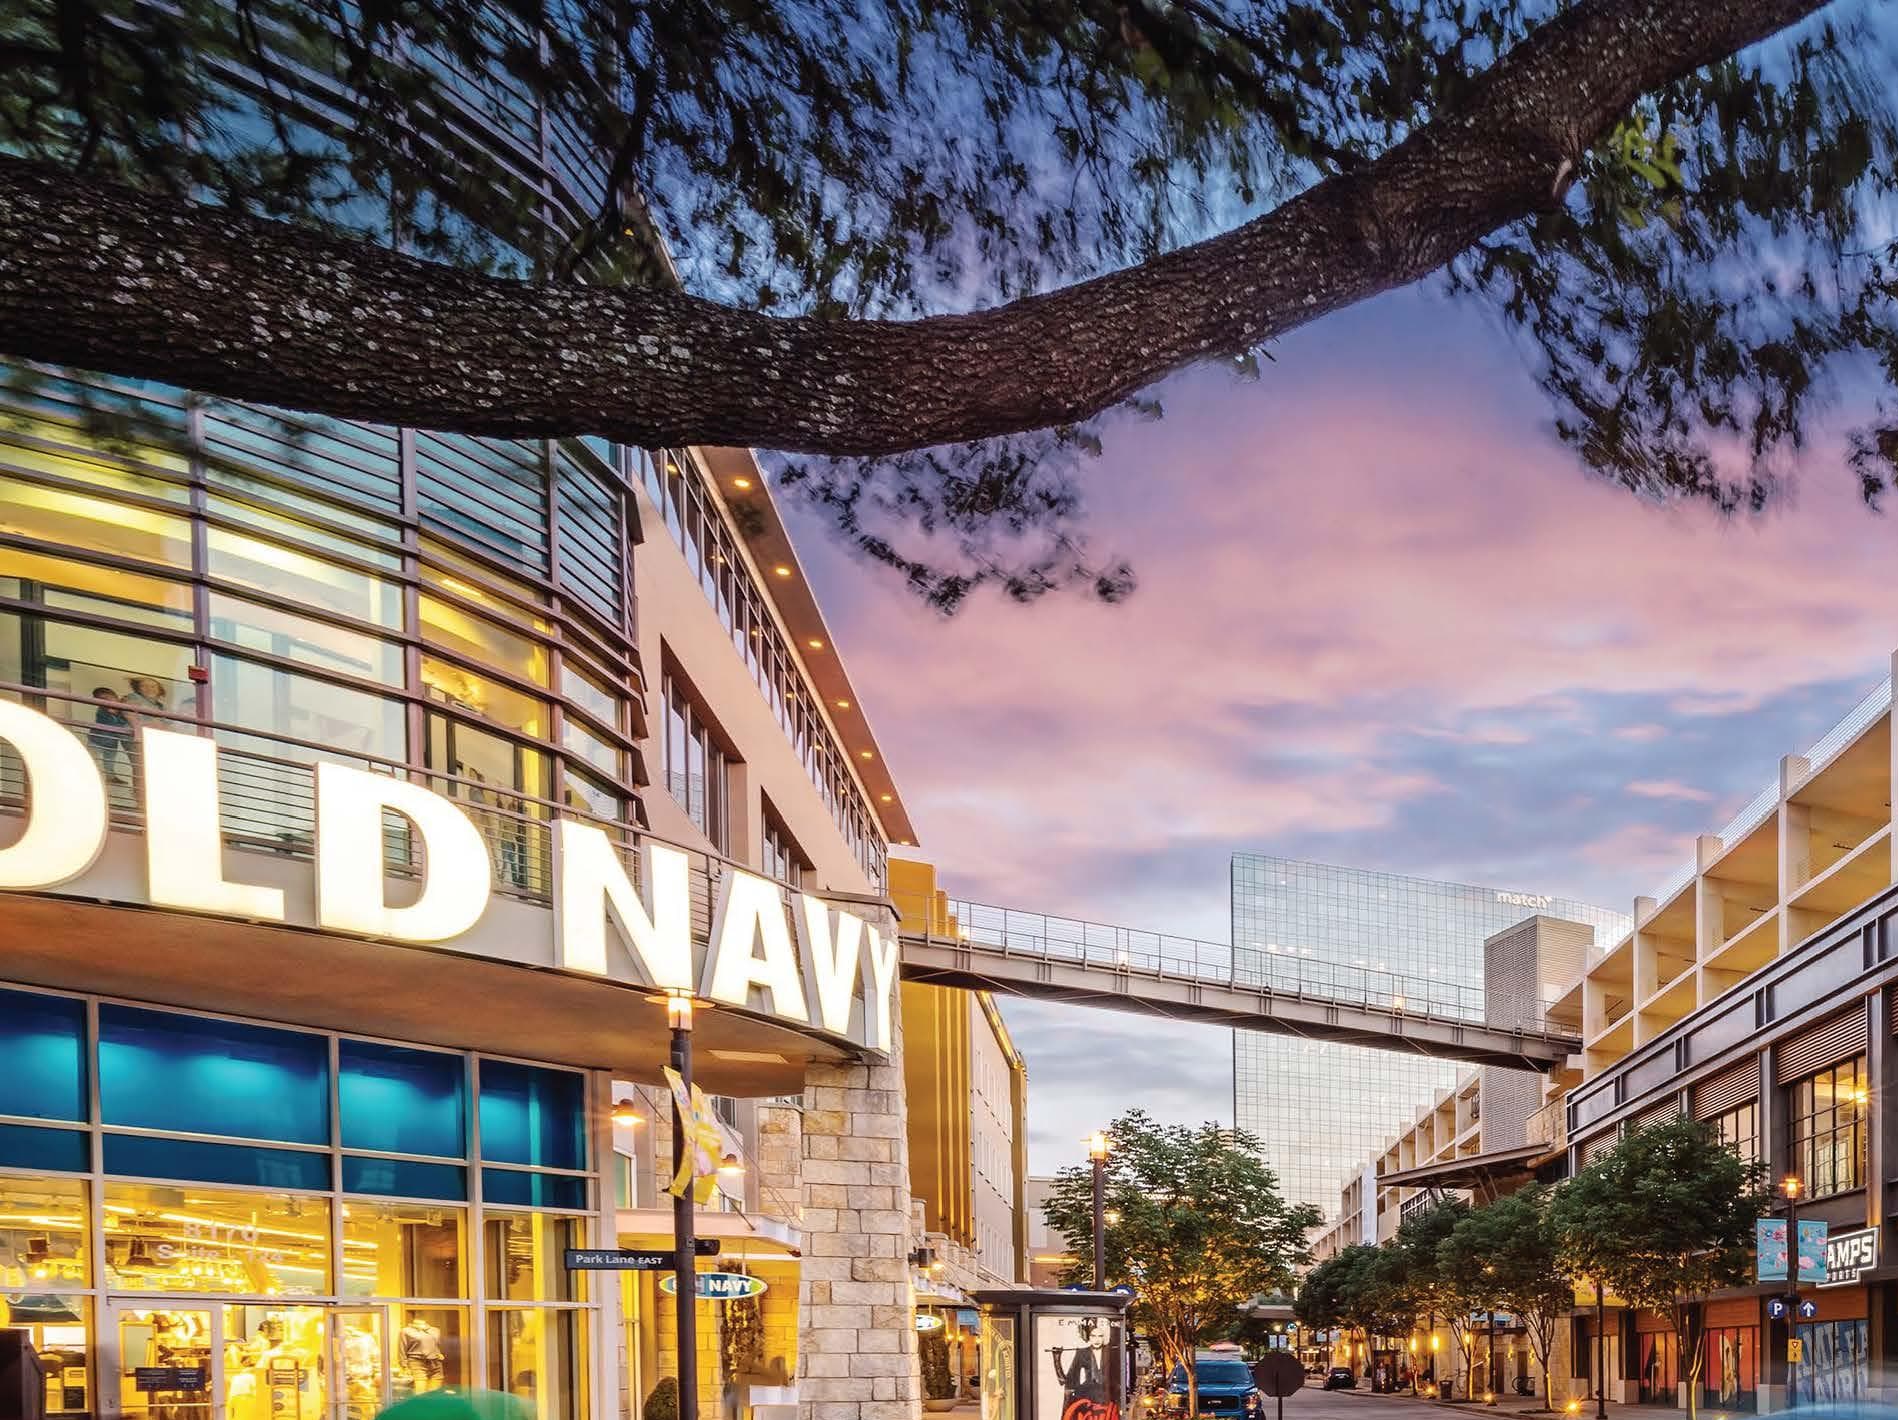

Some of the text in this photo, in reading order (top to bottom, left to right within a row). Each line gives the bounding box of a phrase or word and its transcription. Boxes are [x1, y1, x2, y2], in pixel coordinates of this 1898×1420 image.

[1497, 893, 1548, 909] match
[560, 818, 898, 1059] NAVY
[157, 1243, 219, 1259] Site
[1827, 1235, 1874, 1270] AMPS
[575, 1254, 663, 1265] Park Lane EAST
[1826, 1268, 1857, 1281] PORTS
[709, 1279, 753, 1293] NAVY
[1774, 1303, 1783, 1316] P
